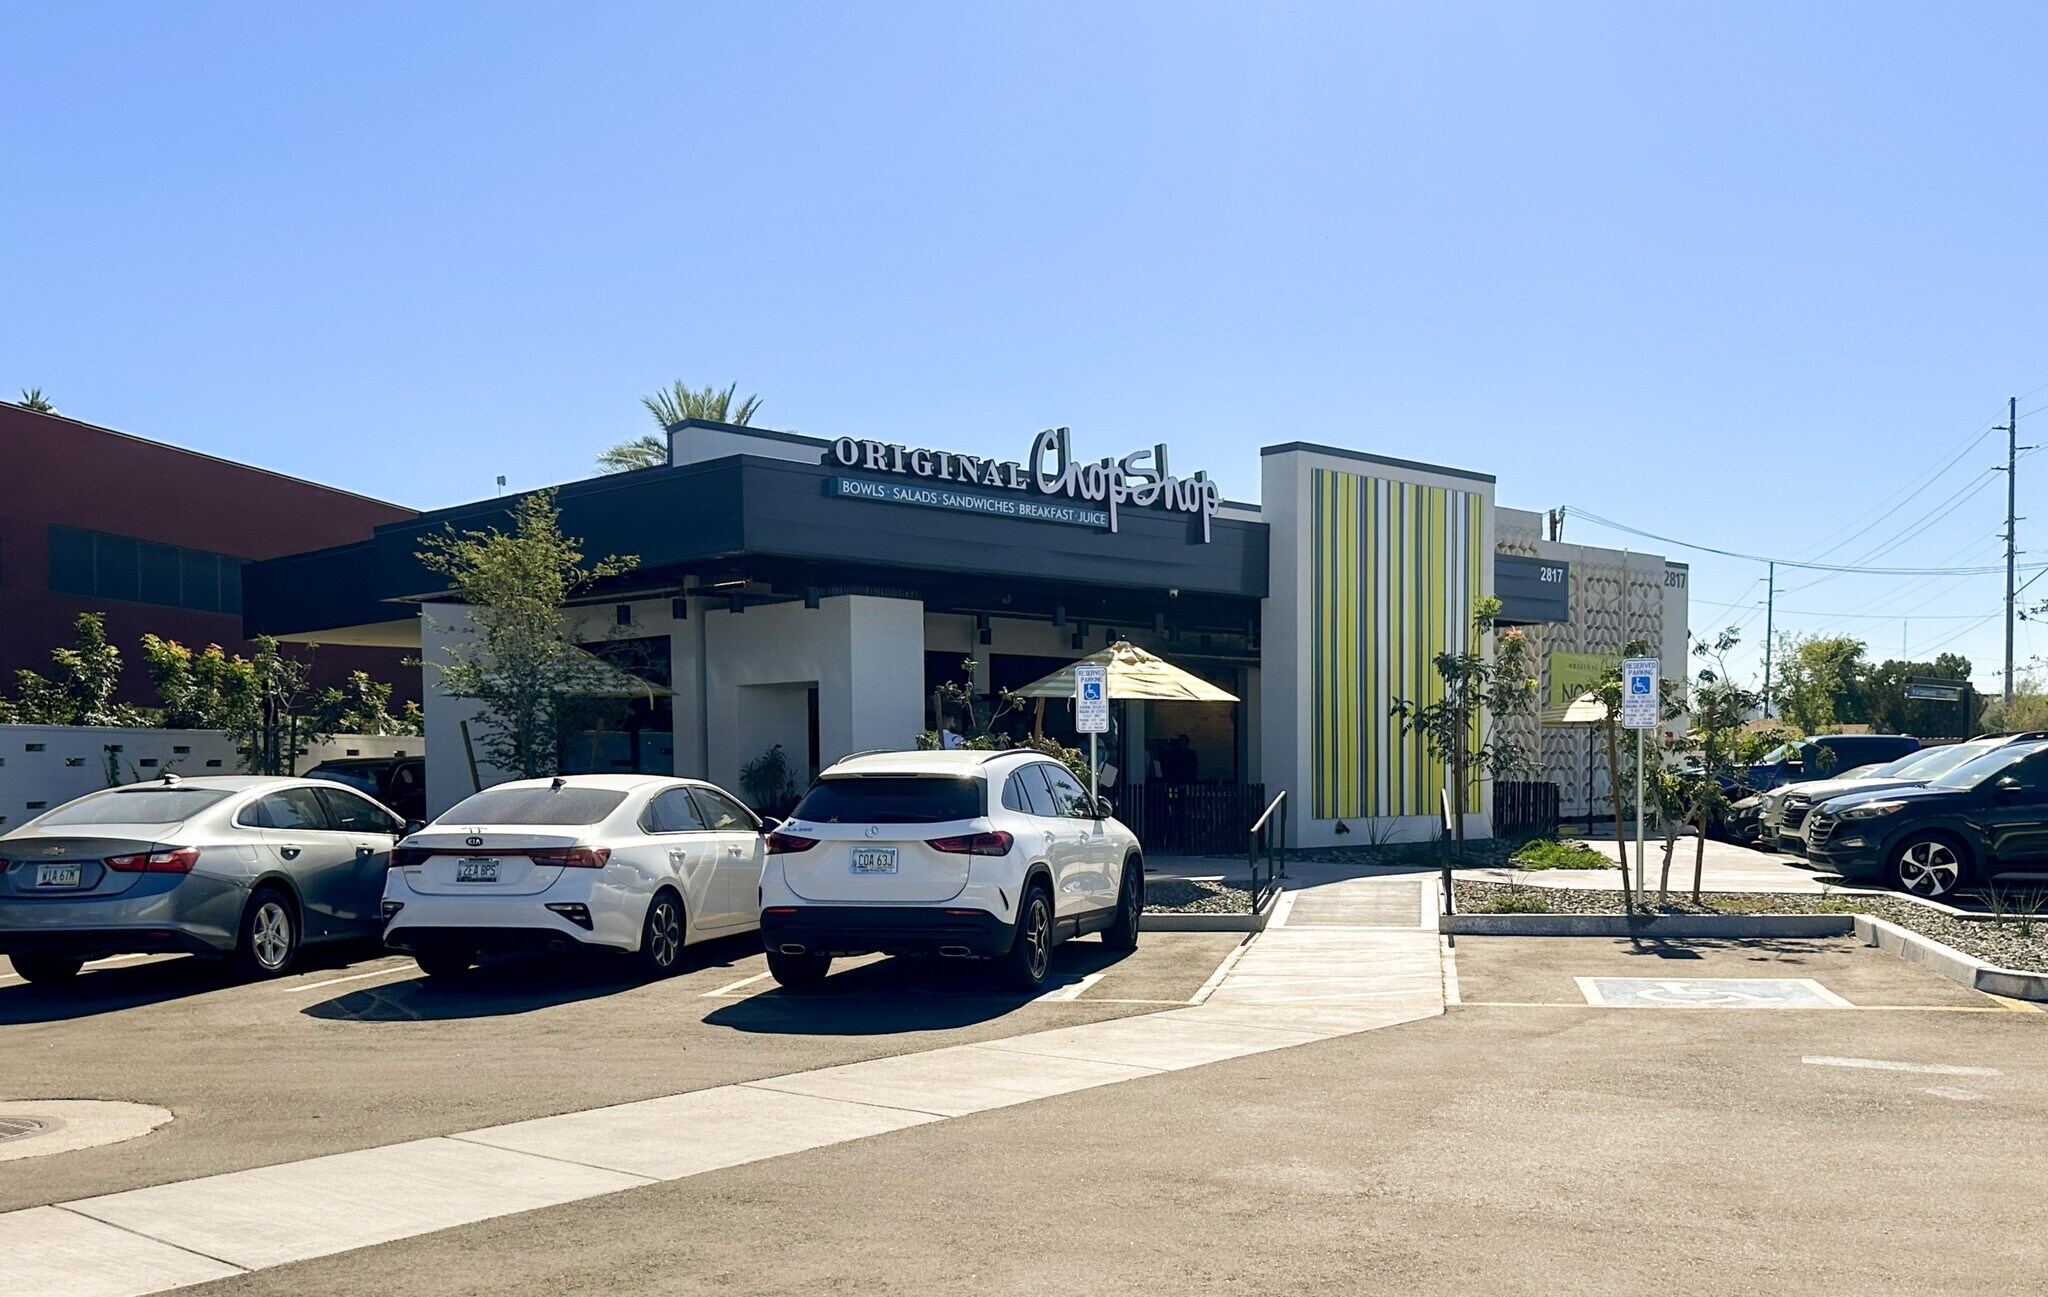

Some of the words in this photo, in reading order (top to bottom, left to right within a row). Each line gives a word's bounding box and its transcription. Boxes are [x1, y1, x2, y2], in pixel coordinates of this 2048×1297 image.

[835, 437, 1028, 490] ORIGINAL
[842, 480, 885, 497] BOWLS
[893, 487, 937, 503] SALADS
[942, 493, 1015, 514] SANDWICHES
[1019, 503, 1074, 521] BREAKFAST
[1078, 512, 1106, 525] JUICE
[1540, 566, 1563, 583] 2817
[1664, 571, 1686, 589] 2817
[1626, 662, 1656, 670] RESERVED
[467, 838, 481, 846] KIA
[876, 853, 893, 867] 63J
